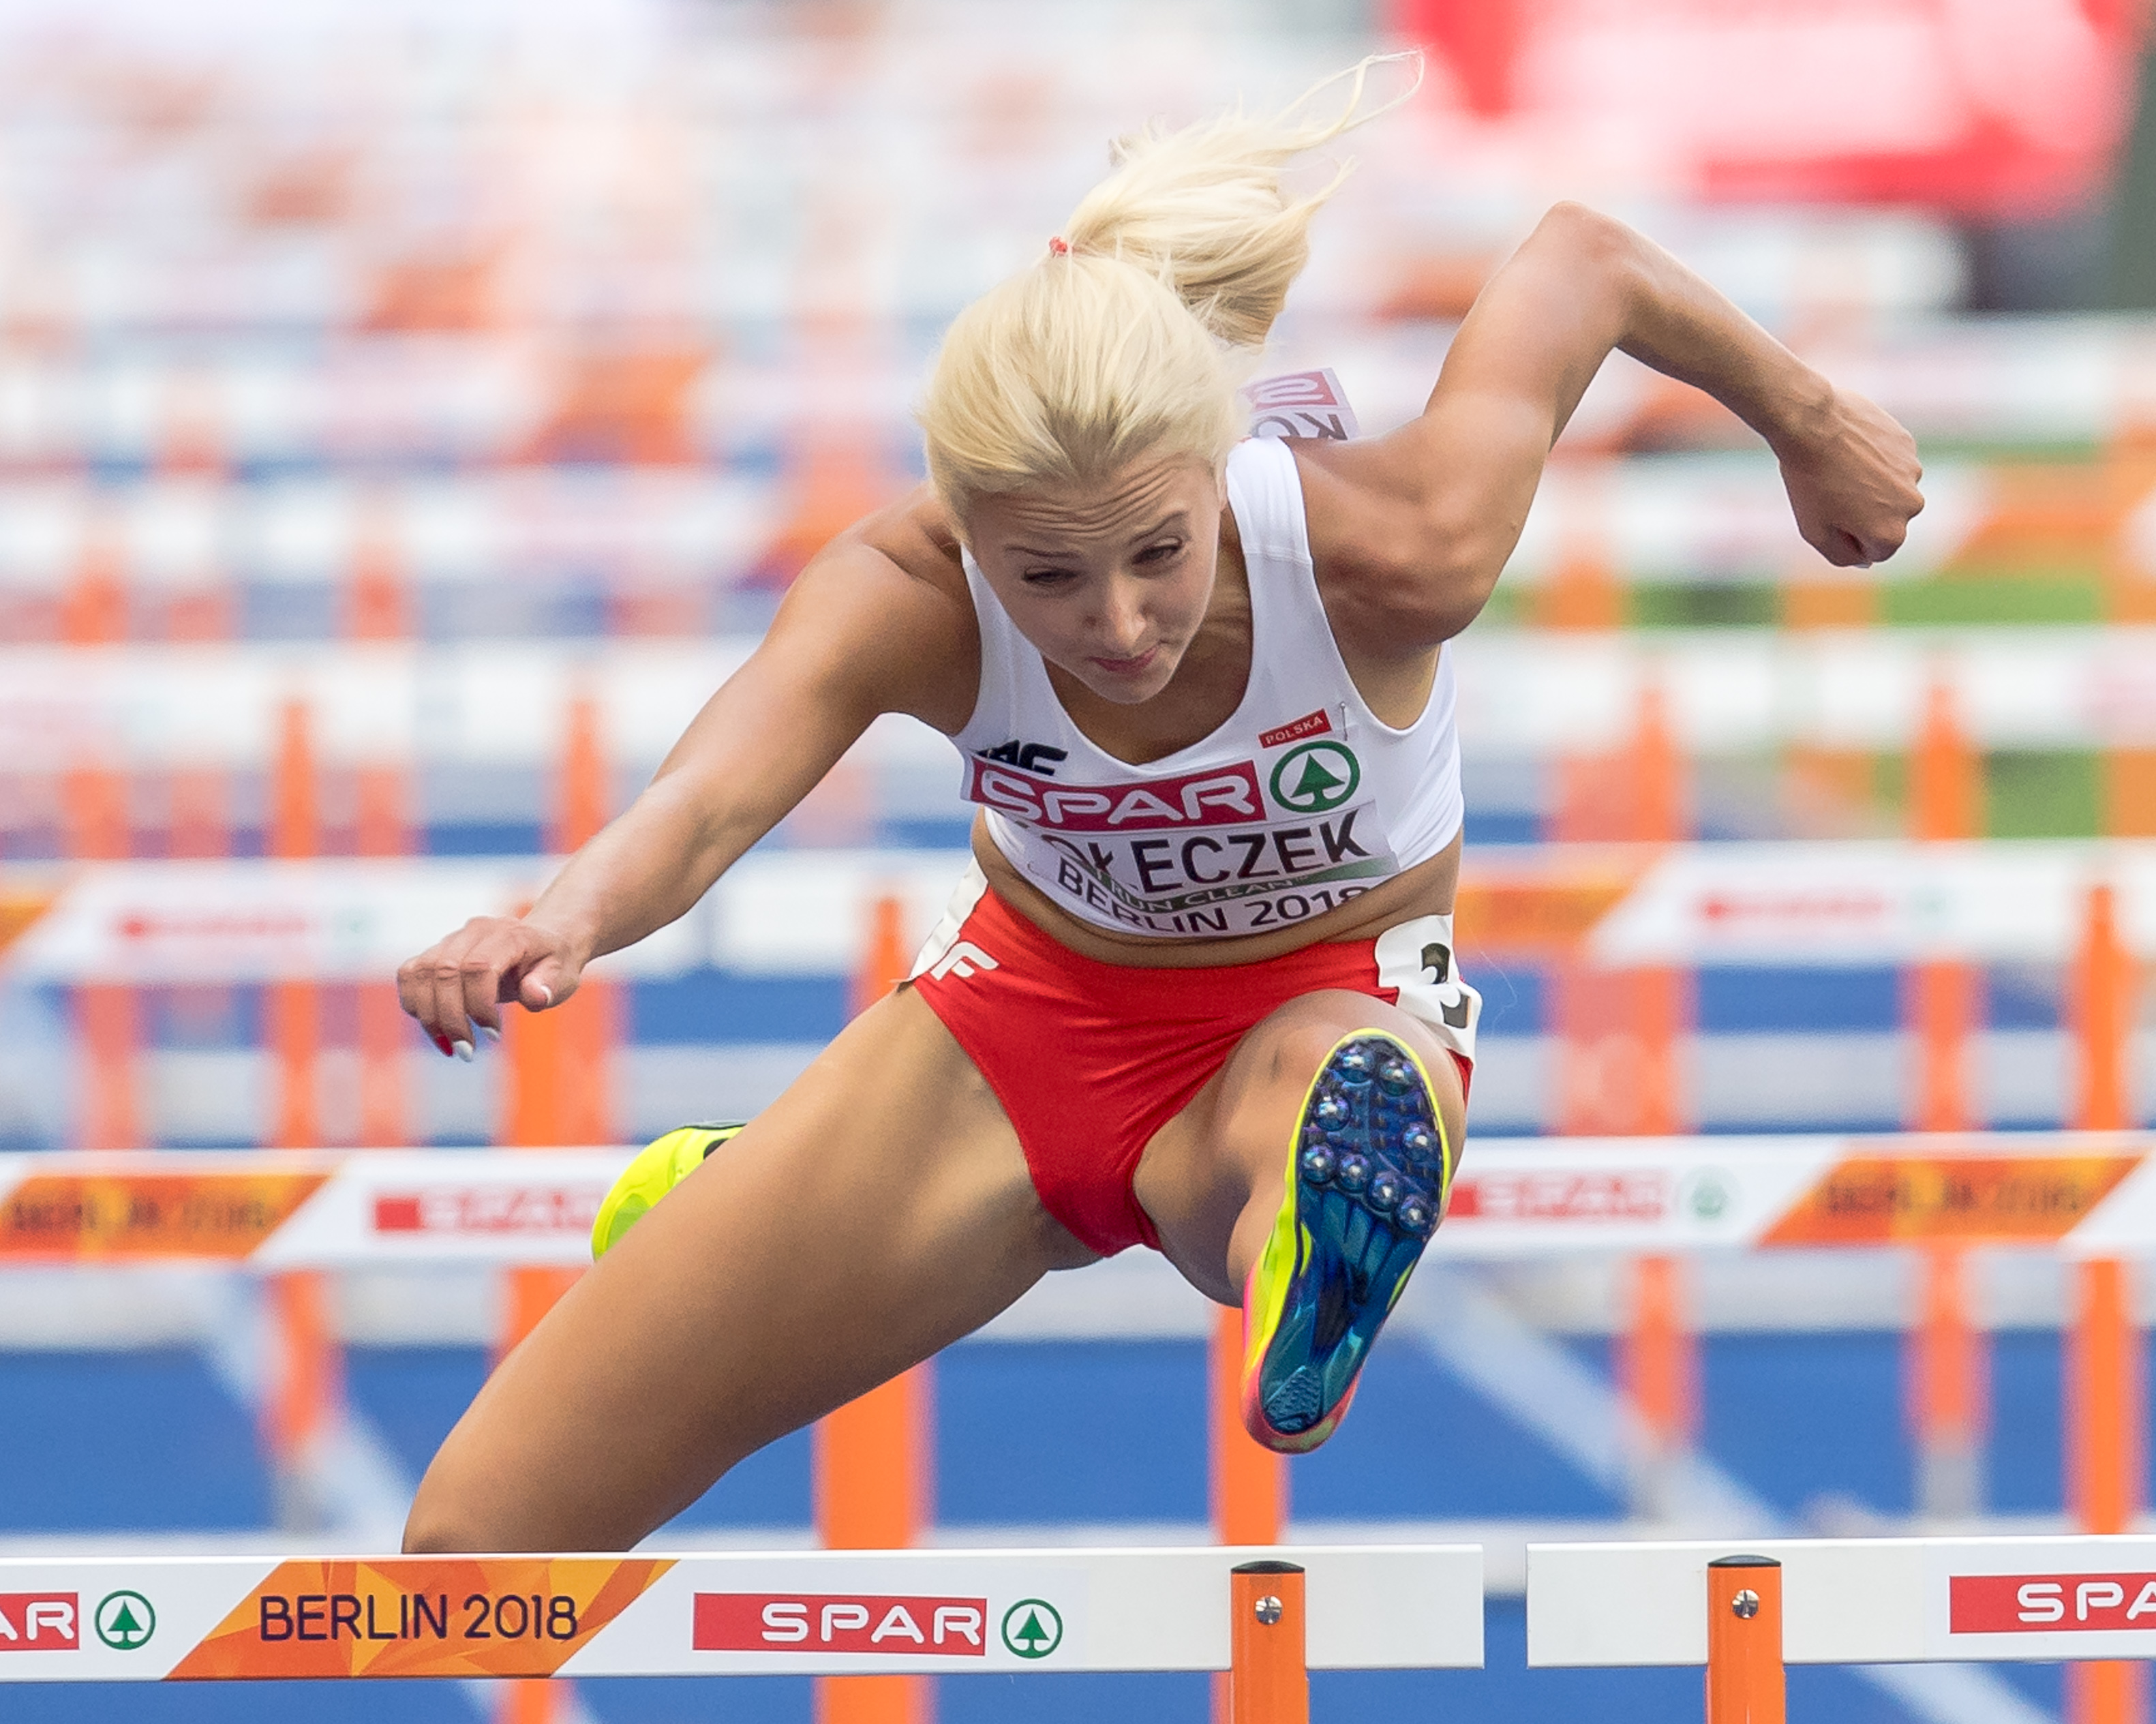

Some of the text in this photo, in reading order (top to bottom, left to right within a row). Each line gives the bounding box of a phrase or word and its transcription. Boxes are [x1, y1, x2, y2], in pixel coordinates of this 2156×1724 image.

[1265, 716, 1323, 744] POLSKA
[981, 770, 1256, 824] SPAR
[1058, 856, 1229, 933] BERLIN
[1111, 879, 1173, 911] RUN
[259, 1593, 579, 1642] BERLIN 2018
[761, 1602, 982, 1646] SPAR
